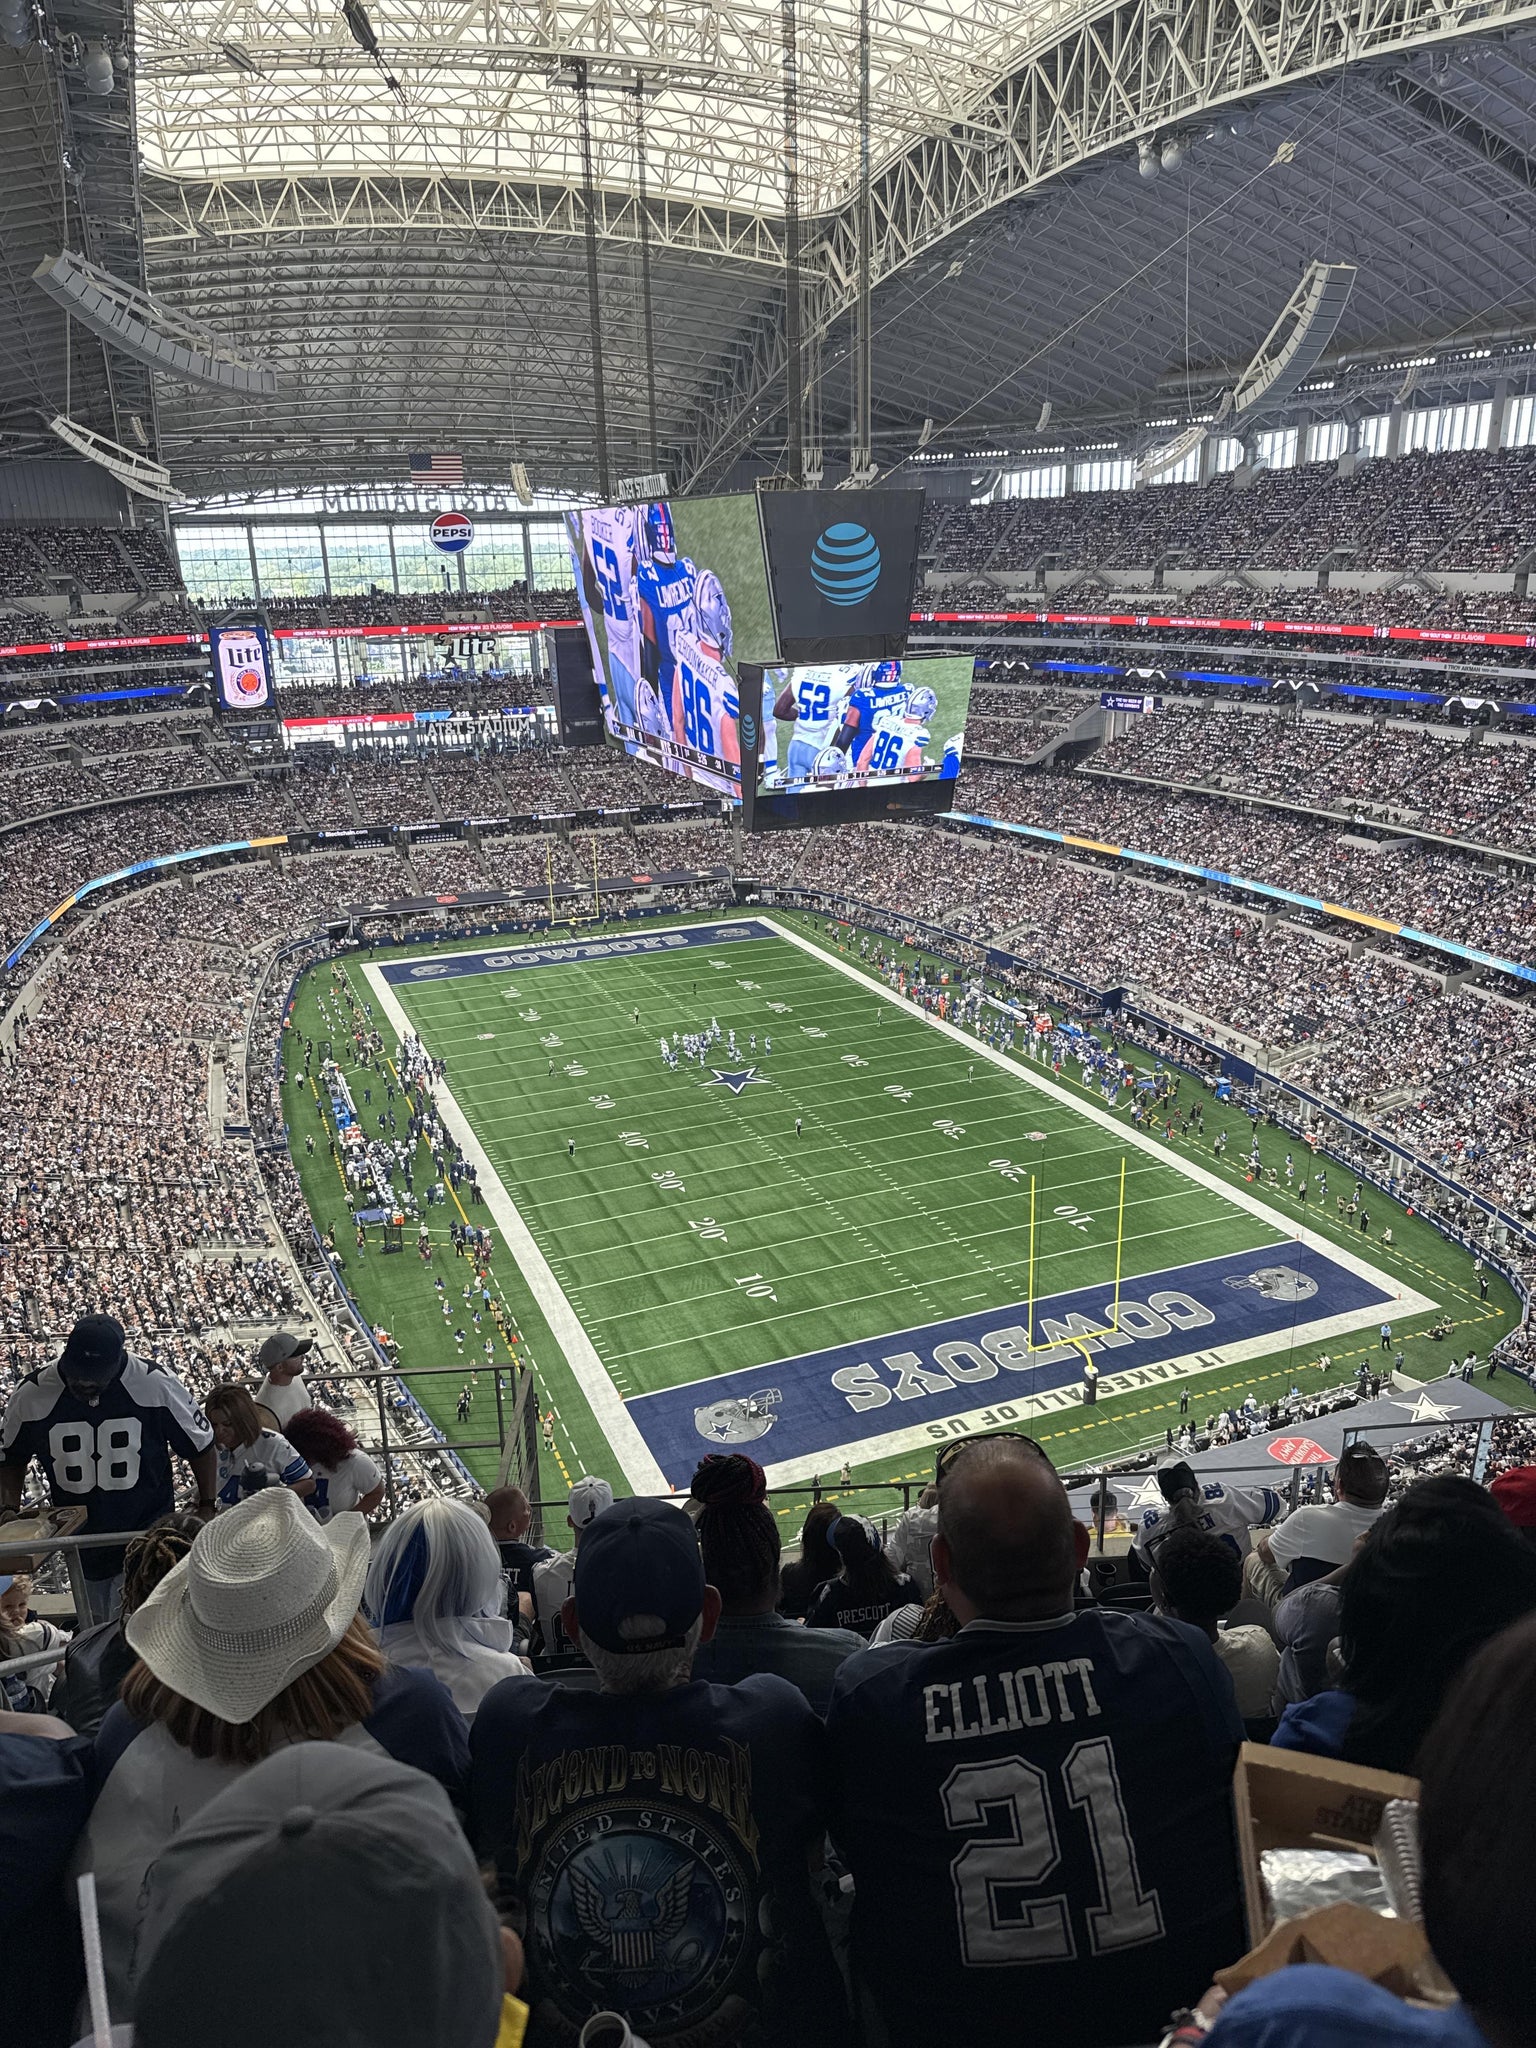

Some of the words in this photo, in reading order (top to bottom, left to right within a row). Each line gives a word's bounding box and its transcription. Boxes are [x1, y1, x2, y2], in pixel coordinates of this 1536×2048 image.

[634, 472, 669, 499] STADIUM
[433, 529, 471, 537] PEPSI
[592, 537, 628, 621] 52
[655, 578, 693, 608] LAWRENCE
[226, 647, 261, 669] Lite
[451, 638, 496, 659] Lite
[681, 661, 715, 755] 86
[798, 681, 831, 722] 52
[870, 691, 908, 709] LAWRENCE
[427, 722, 463, 737] AT&T
[467, 718, 531, 735] STADIUM
[870, 731, 904, 770] 86
[400, 823, 441, 832] Blockchain.com
[470, 818, 510, 826] Blockchain.com
[325, 829, 368, 838] Blockchain.com
[483, 934, 689, 968] COWBOYS
[710, 960, 732, 970] 10
[500, 988, 522, 999] 10
[518, 1009, 542, 1022] 20
[768, 1002, 793, 1014] 30
[540, 1036, 564, 1048] 30
[802, 1027, 829, 1039] 40
[563, 1064, 589, 1077] 40
[840, 1054, 869, 1068] 50
[883, 1084, 914, 1099] 40
[588, 1094, 616, 1110] 50
[932, 1119, 966, 1136] 30
[617, 1131, 648, 1147] 40
[988, 1159, 1028, 1179] 20
[651, 1170, 684, 1190] 30
[1053, 1205, 1096, 1225] 10
[687, 1217, 726, 1239] 20
[733, 1273, 774, 1298] 10
[831, 1290, 1216, 1413] COWBOYS
[1198, 1351, 1228, 1369] IT
[1097, 1360, 1190, 1394] TAKES
[1026, 1386, 1088, 1412] ALL
[979, 1405, 1020, 1428] OF
[926, 1417, 972, 1439] US
[49, 1416, 143, 1494] 88
[1278, 1439, 1297, 1460] ARMY
[1288, 1440, 1315, 1465] SALVATION
[1306, 1451, 1323, 1464] THE
[1201, 1482, 1225, 1500] 82
[836, 1602, 891, 1627] PRESCOTT
[923, 1658, 1102, 1743] ELLIOTT
[514, 1743, 627, 1881] SECOND
[631, 1751, 658, 1780] TO
[657, 1734, 762, 1884] NONE
[536, 1813, 614, 1913] UNITED
[638, 1810, 741, 1903] STATES
[939, 1735, 1166, 1968] 21
